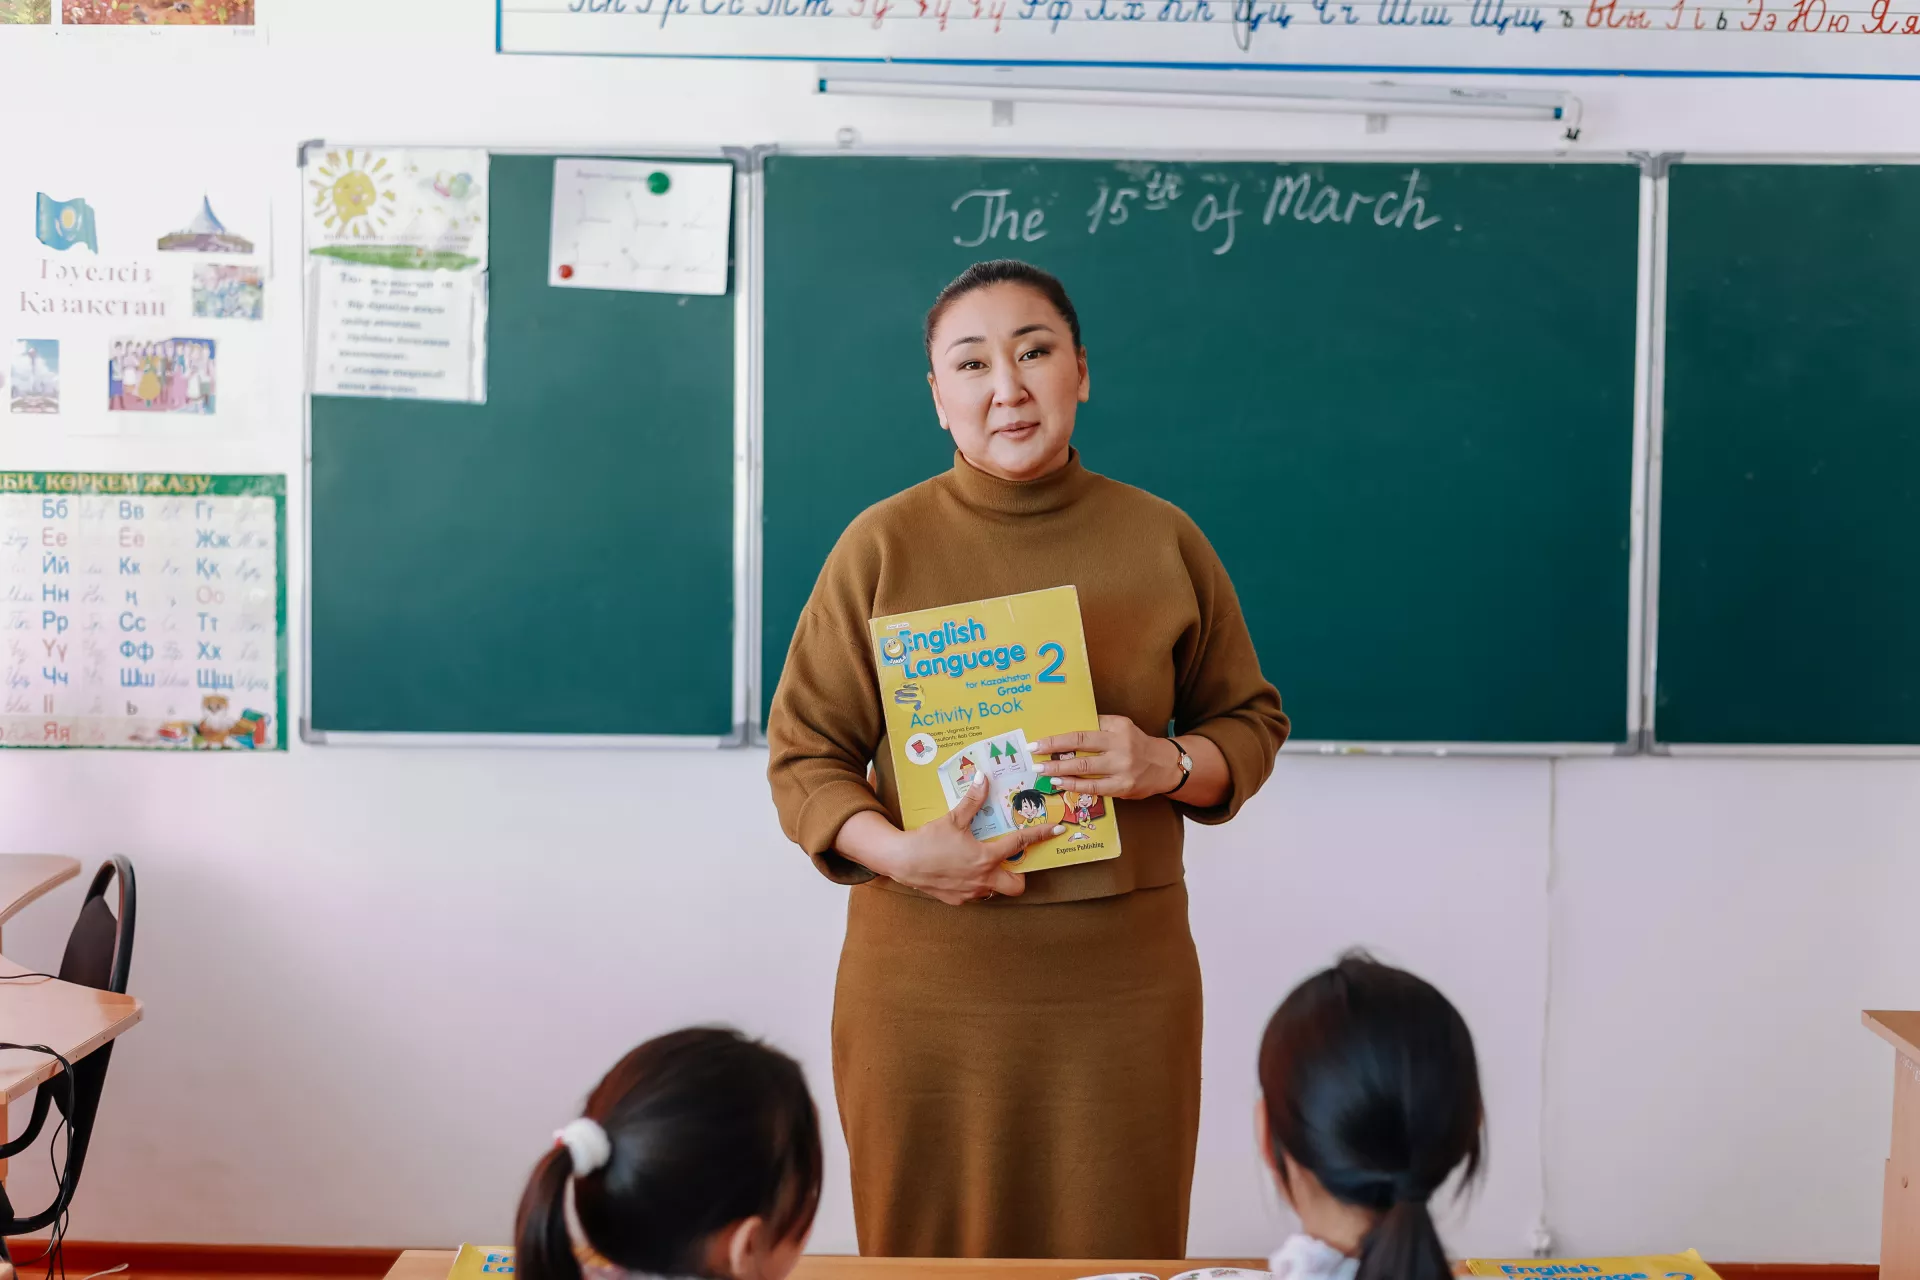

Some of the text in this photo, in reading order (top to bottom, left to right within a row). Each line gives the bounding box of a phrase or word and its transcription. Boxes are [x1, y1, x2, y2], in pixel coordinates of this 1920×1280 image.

[1787, 0, 1850, 33] Юю
[952, 189, 1049, 247] The
[1191, 182, 1244, 255] of
[904, 643, 1027, 680] Language
[1037, 641, 1066, 684] 2
[965, 673, 1032, 690] for Kazakhstan
[997, 682, 1033, 697] Grade
[910, 697, 1025, 729] Activity Book
[1056, 841, 1105, 855] Express Publishing
[1499, 1263, 1601, 1277] English
